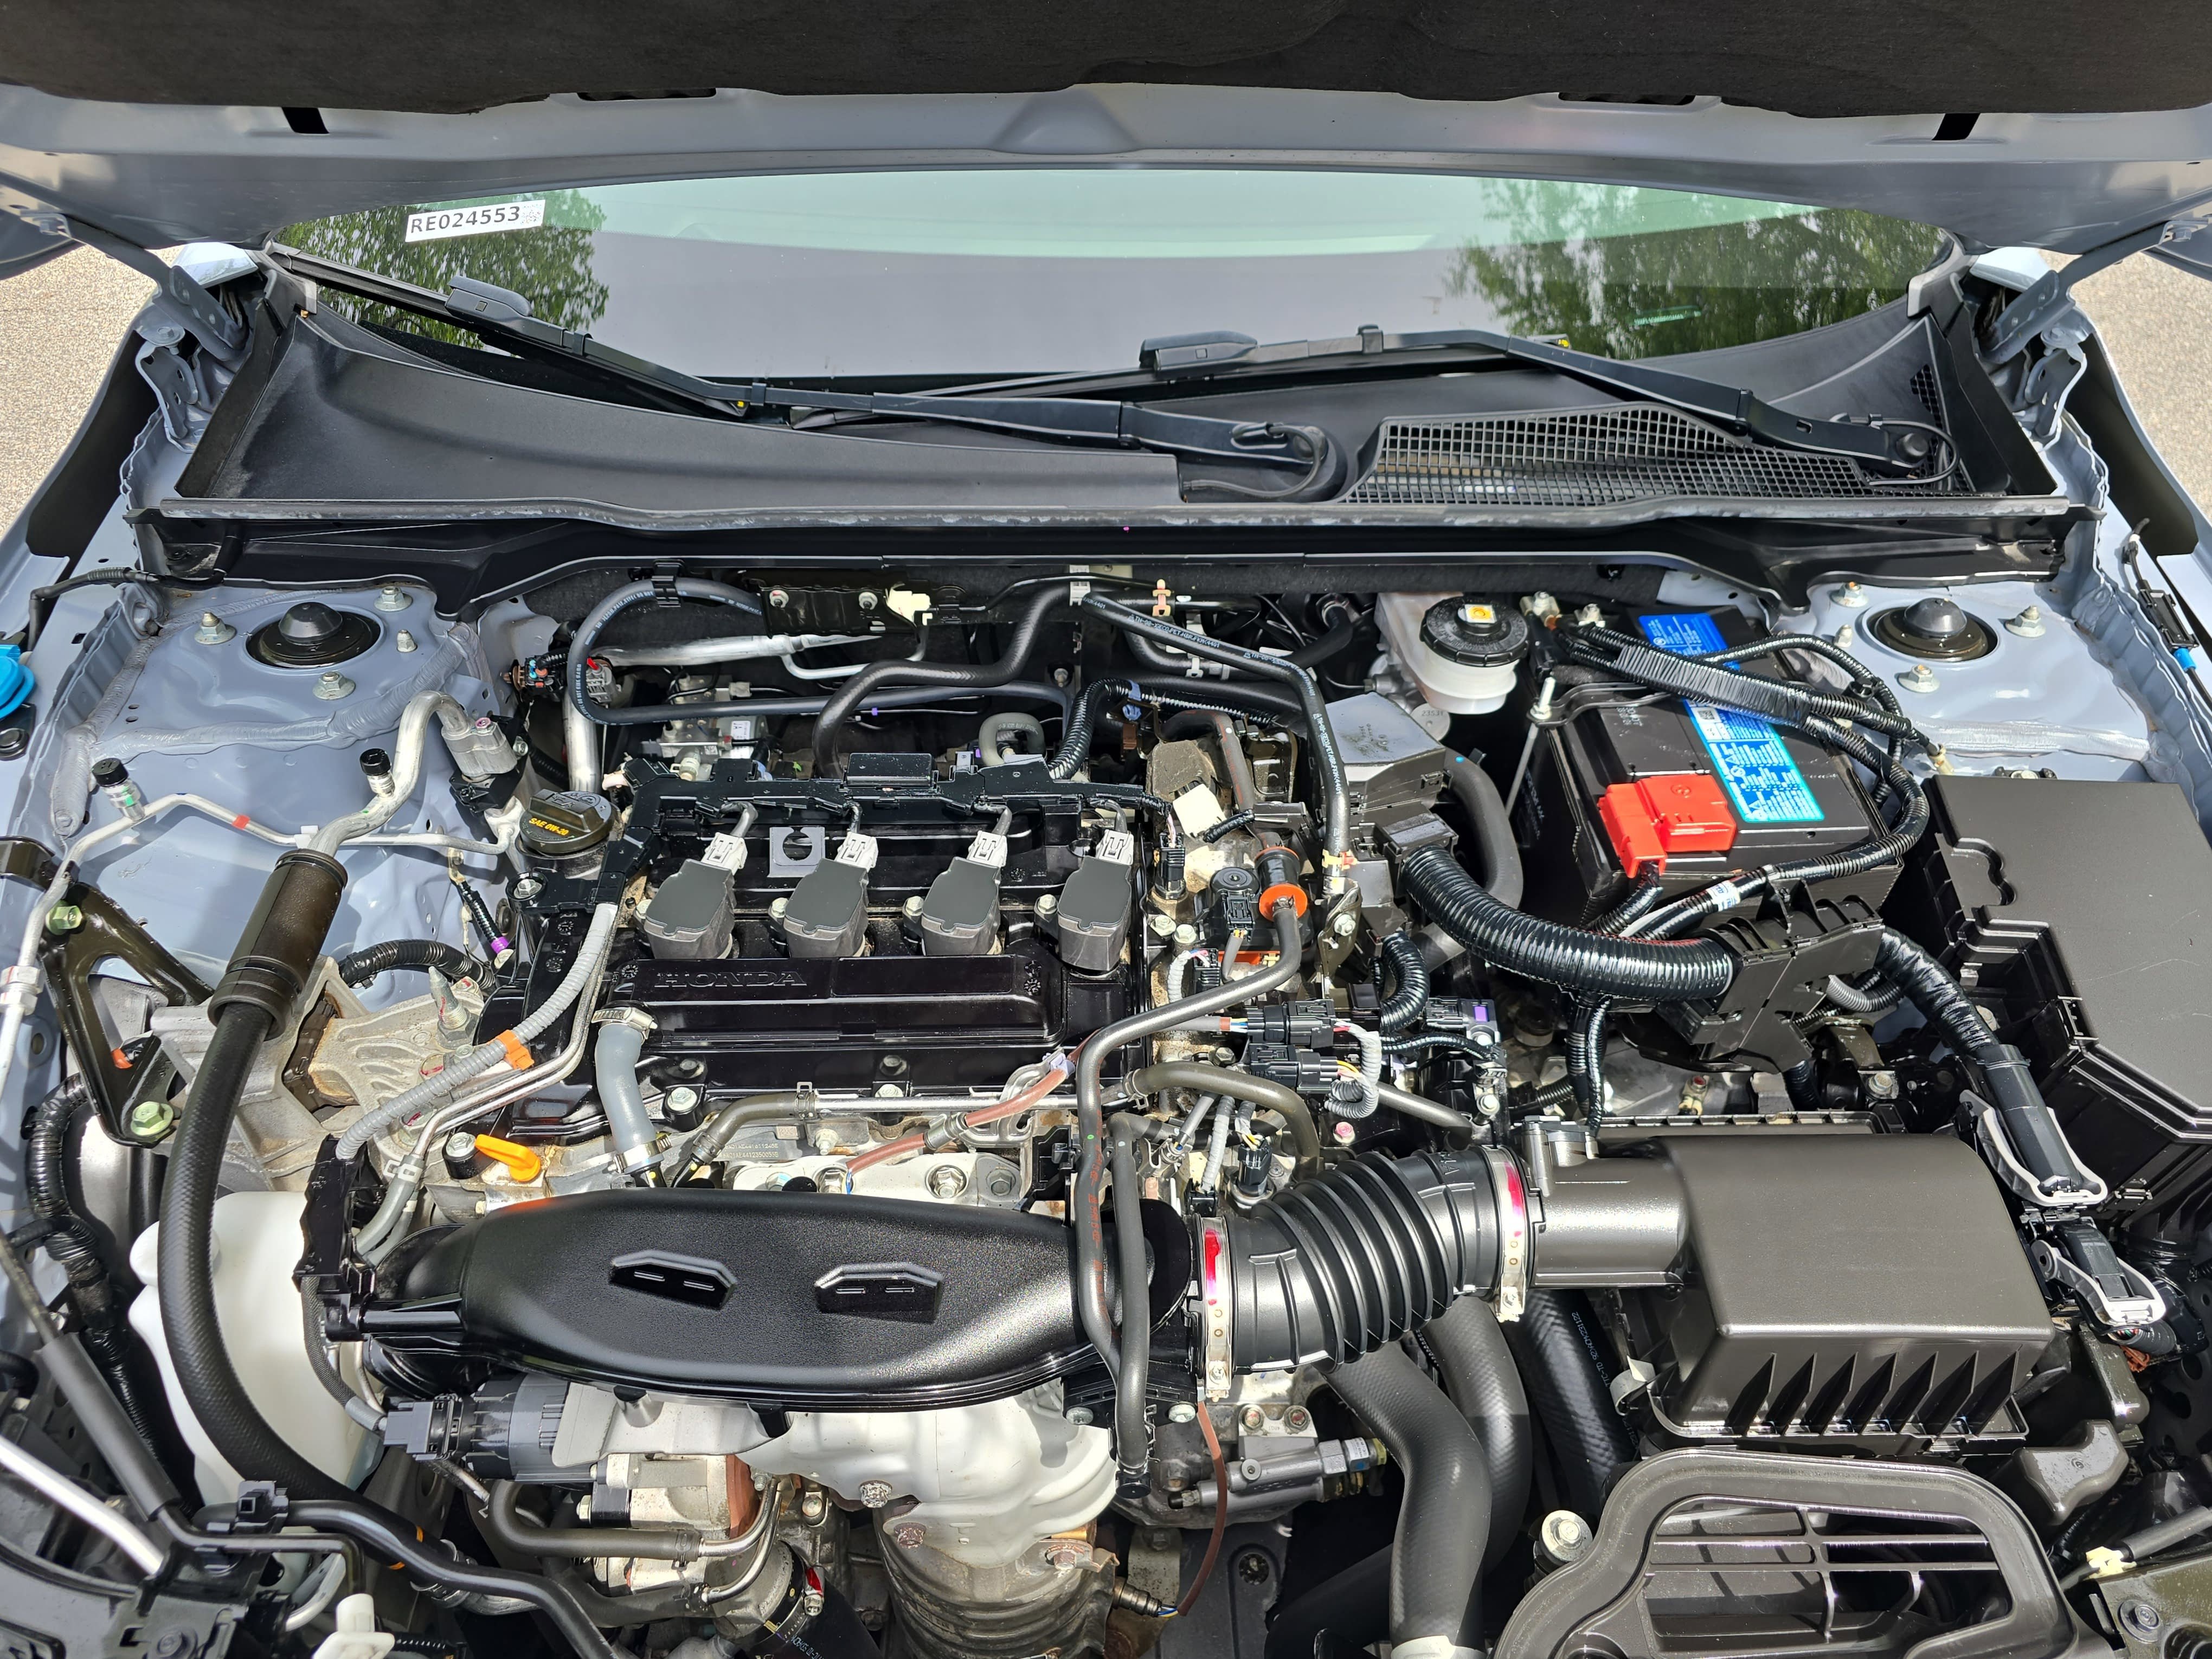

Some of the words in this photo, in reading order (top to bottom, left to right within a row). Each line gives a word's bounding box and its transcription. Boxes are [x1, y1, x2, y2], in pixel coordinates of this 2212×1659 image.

[410, 205, 520, 233] RE024553
[529, 818, 546, 828] SAE
[544, 823, 569, 836] 0W-20
[654, 971, 807, 988] HONDA
